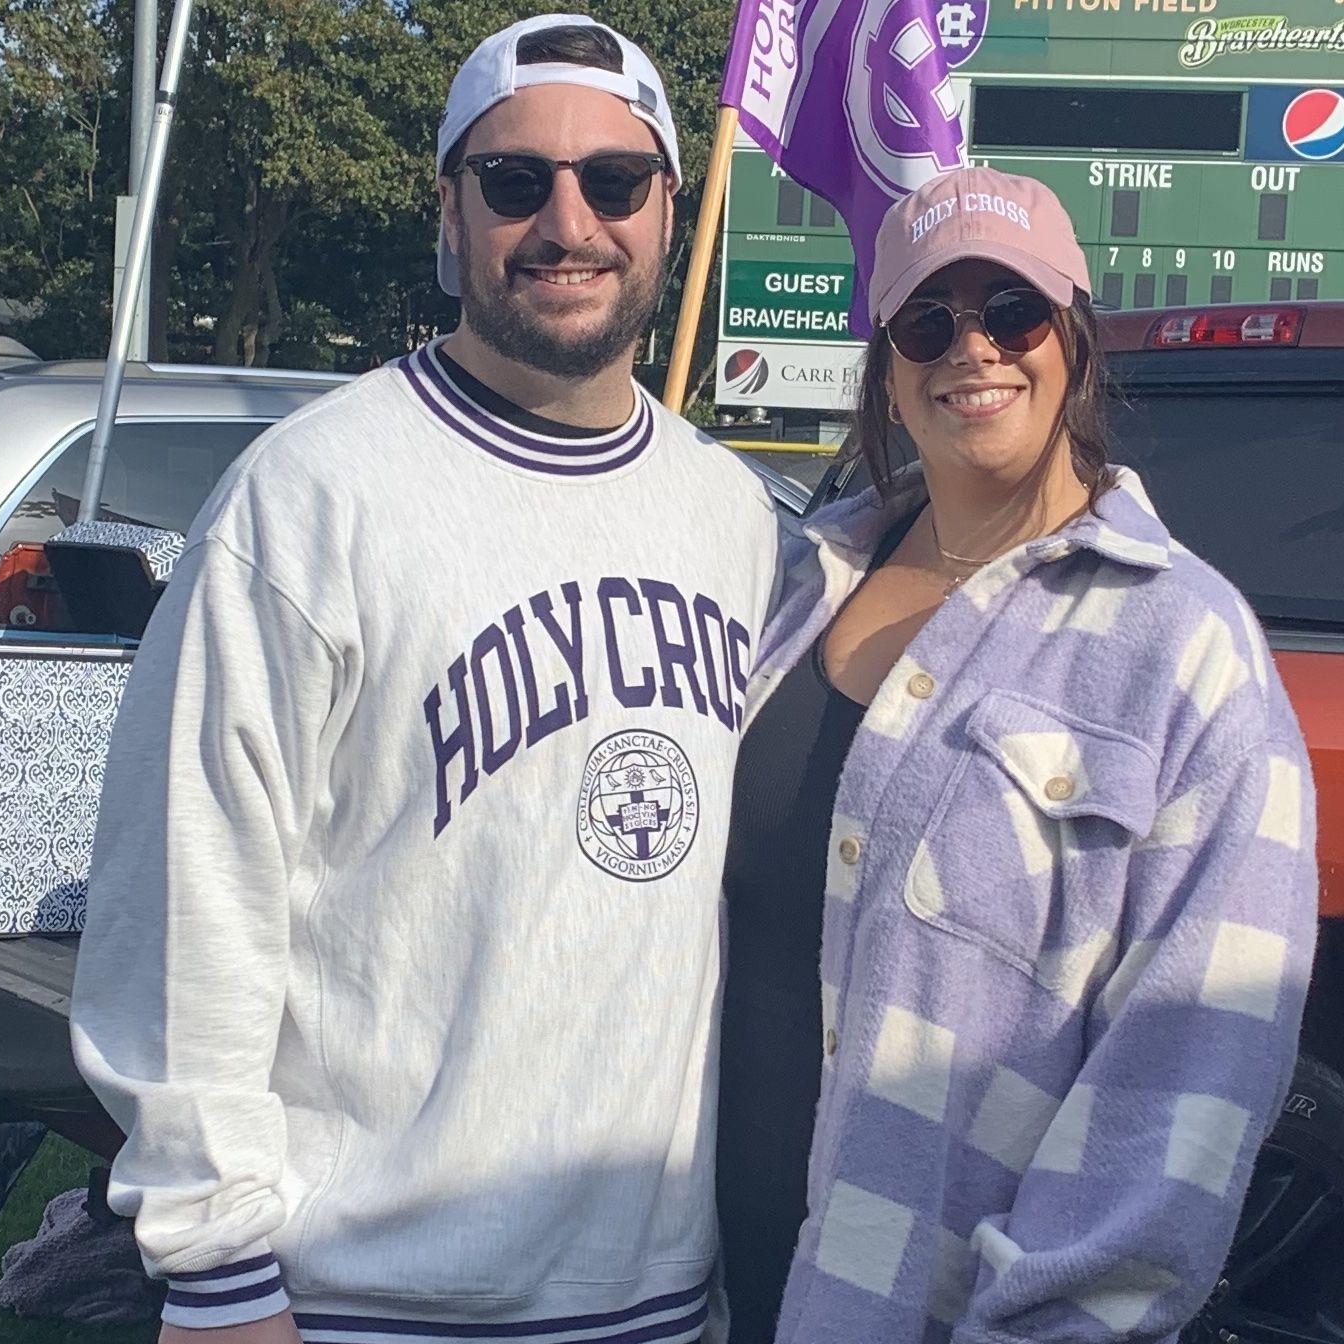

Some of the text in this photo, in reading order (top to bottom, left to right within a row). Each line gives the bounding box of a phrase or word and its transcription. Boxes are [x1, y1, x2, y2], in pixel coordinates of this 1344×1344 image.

[1088, 163, 1173, 189] STRIKE
[1251, 166, 1300, 192] OUT
[911, 193, 1031, 244] HOLY CROSS
[746, 233, 805, 242] DAKTRONICS
[1108, 247, 1119, 267] 7
[1142, 248, 1153, 268] 8
[1175, 249, 1186, 269] 9
[1212, 250, 1236, 271] 10
[1267, 252, 1324, 274] RUNS
[764, 273, 845, 294] GUEST
[729, 307, 848, 332] BRAVEHEAR
[423, 577, 751, 840] HOLY CROS
[607, 735, 664, 755] SANCTAE
[666, 747, 694, 795] CRUCIS
[595, 838, 686, 875] VIGORNII MASS
